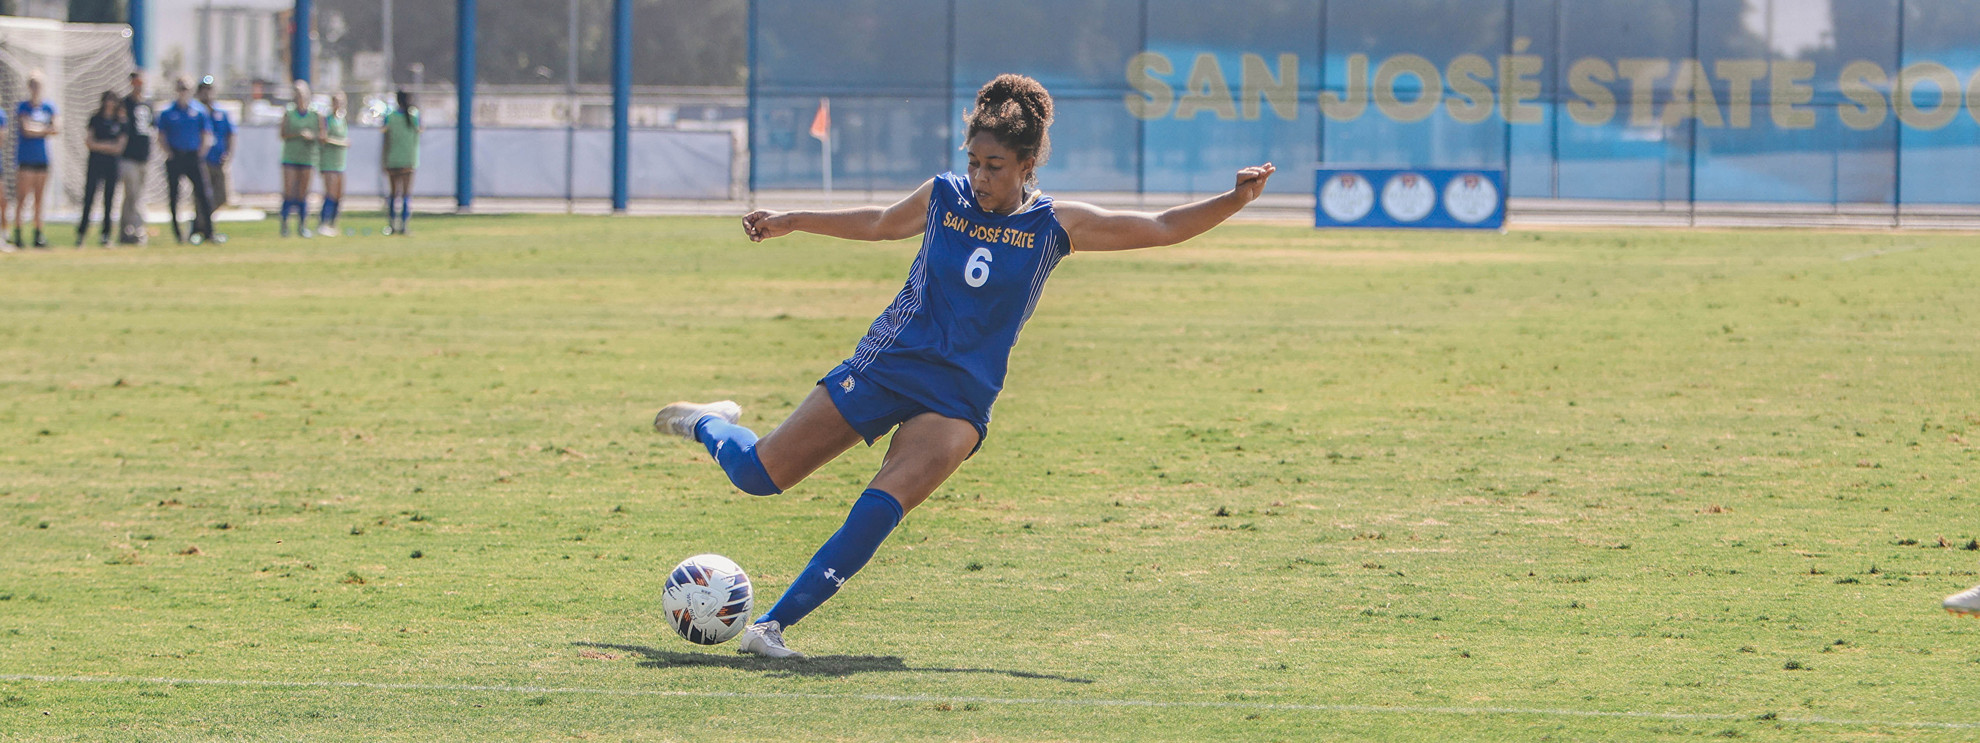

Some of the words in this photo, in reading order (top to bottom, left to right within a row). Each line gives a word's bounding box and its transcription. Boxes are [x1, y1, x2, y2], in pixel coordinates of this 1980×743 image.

[1125, 51, 1299, 120] SAN
[1318, 37, 1543, 124] JOSÉ
[1566, 57, 1816, 129] STATE
[1838, 60, 1980, 131] SO
[943, 211, 968, 233] SAN
[969, 224, 1002, 244] JOSÉ
[1002, 228, 1035, 249] STATE
[964, 247, 993, 288] 6
